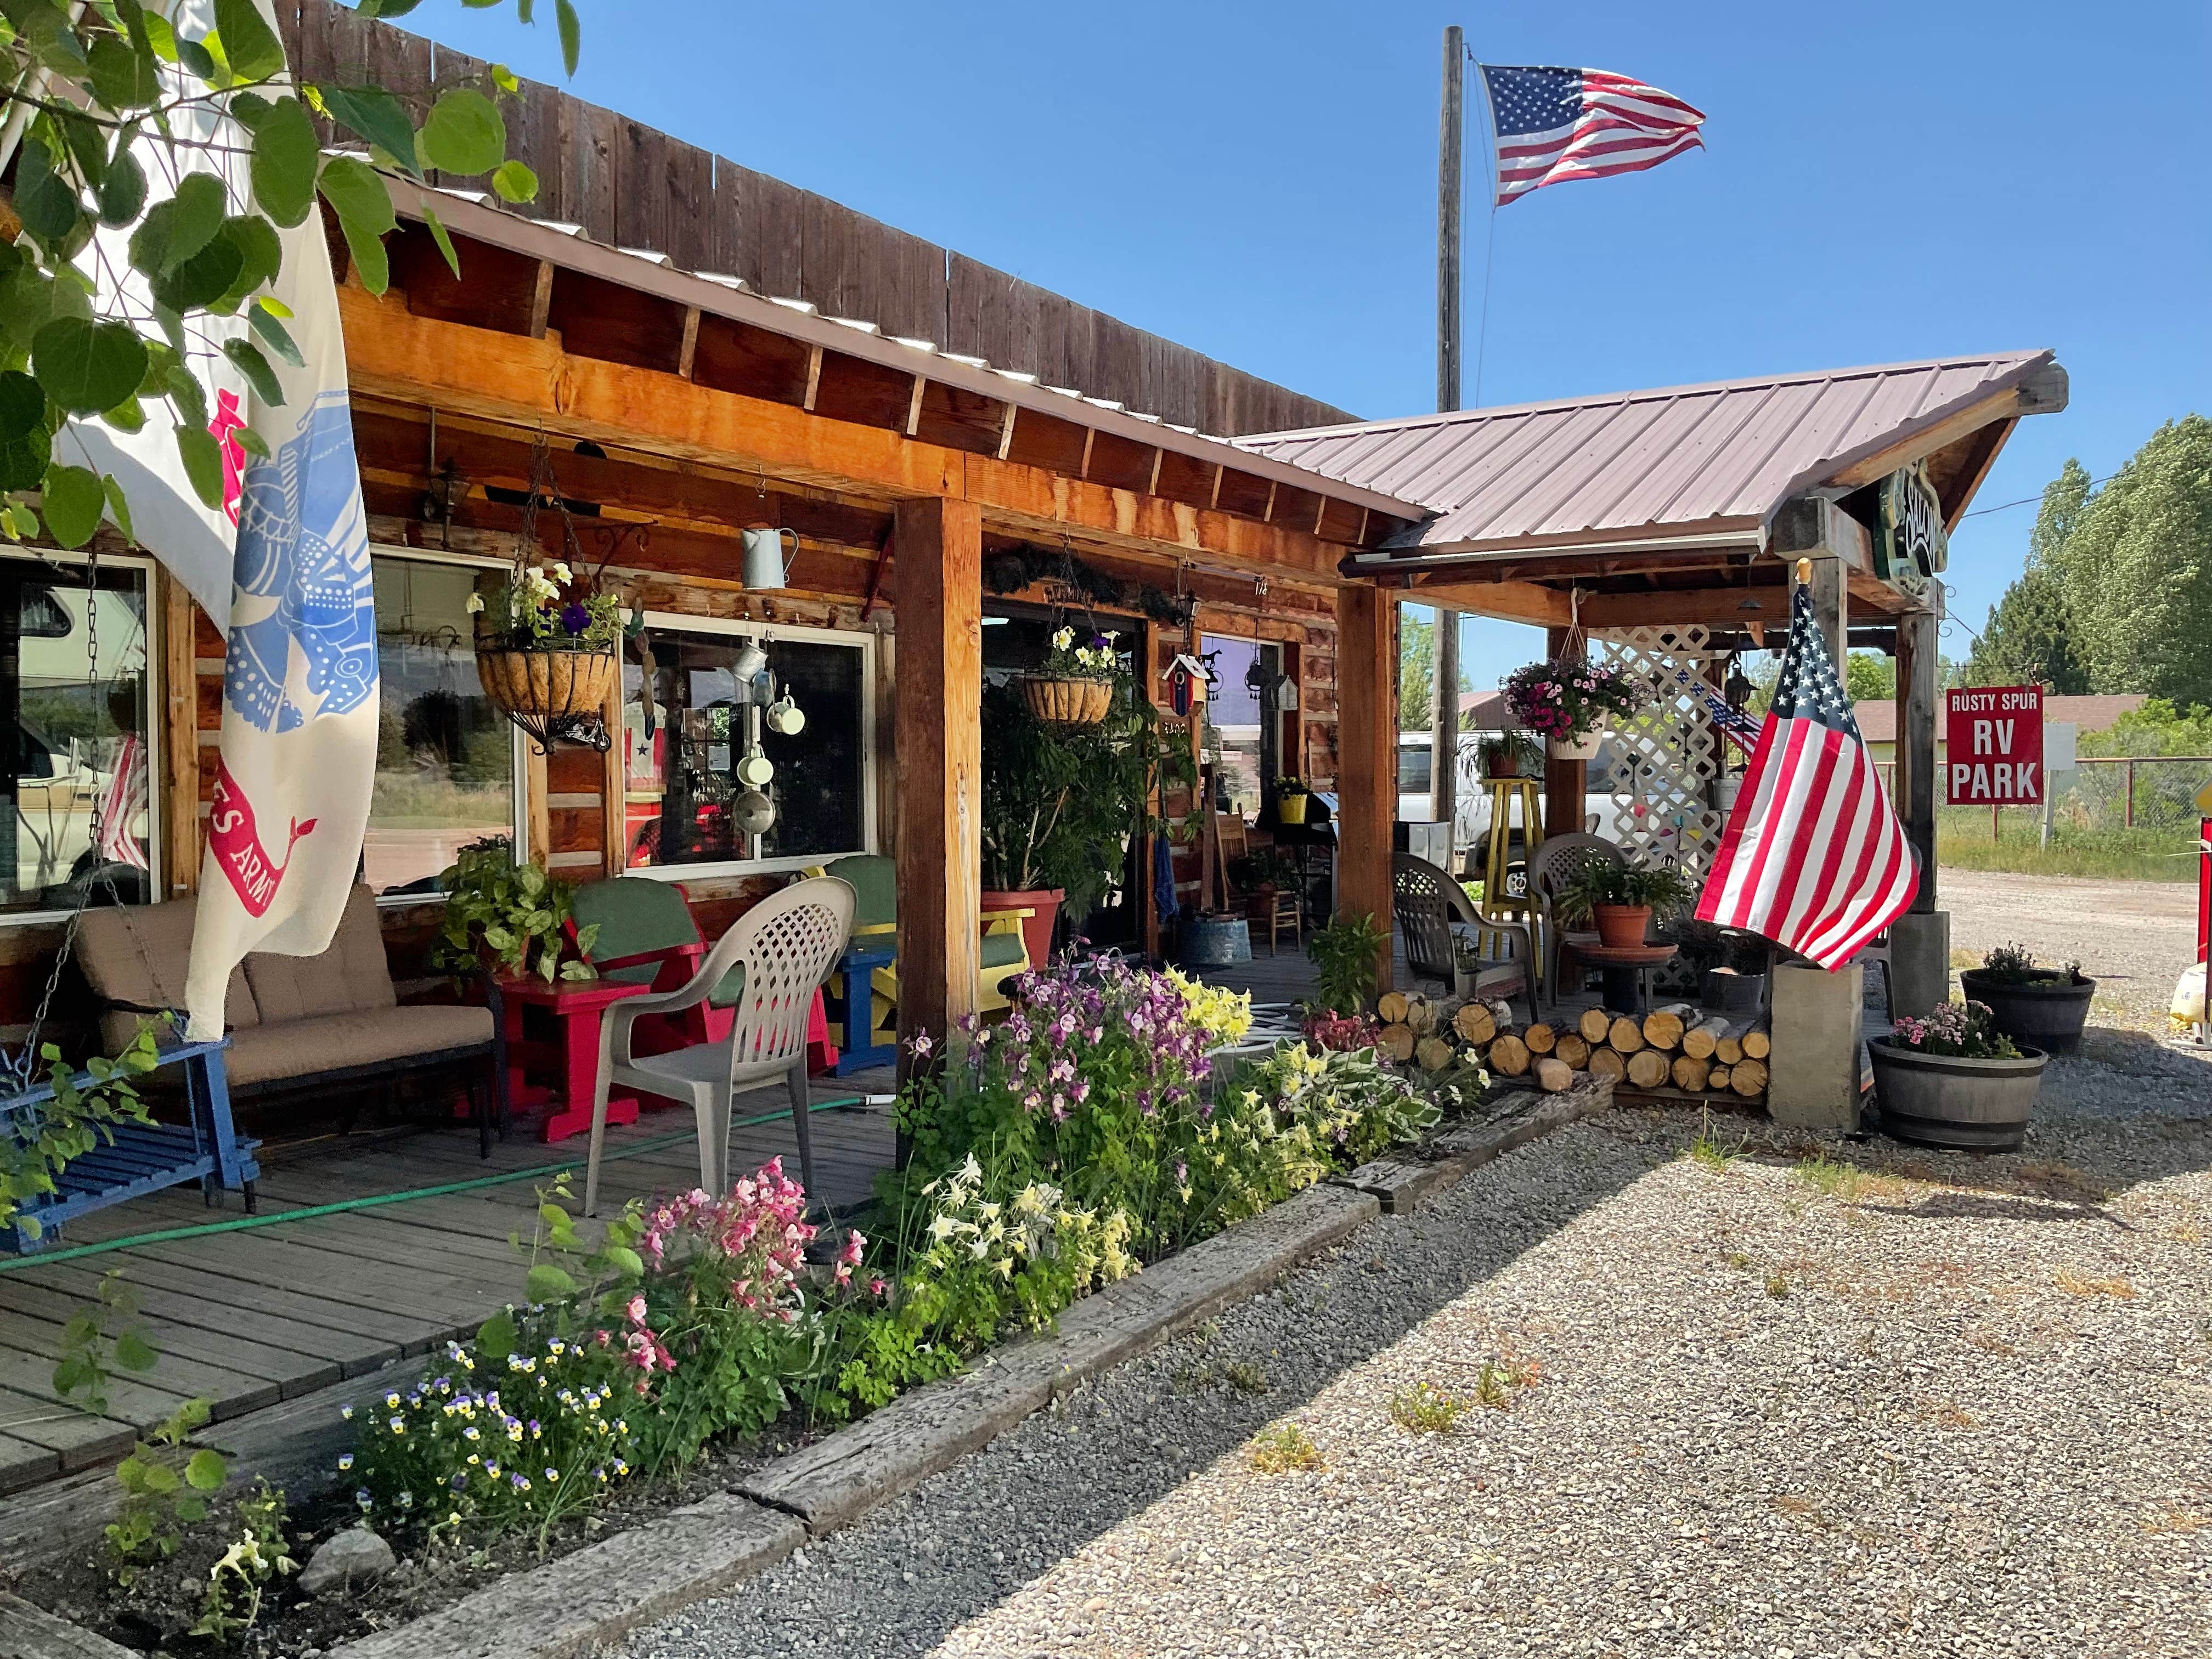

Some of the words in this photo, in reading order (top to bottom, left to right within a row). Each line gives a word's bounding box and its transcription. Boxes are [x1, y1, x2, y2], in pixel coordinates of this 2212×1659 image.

[1952, 694, 1995, 712] RUSTY
[2002, 692, 2037, 710] SPUR
[1974, 719, 2014, 755] RV
[1952, 763, 2038, 798] PARK
[229, 842, 276, 906] ARMY
